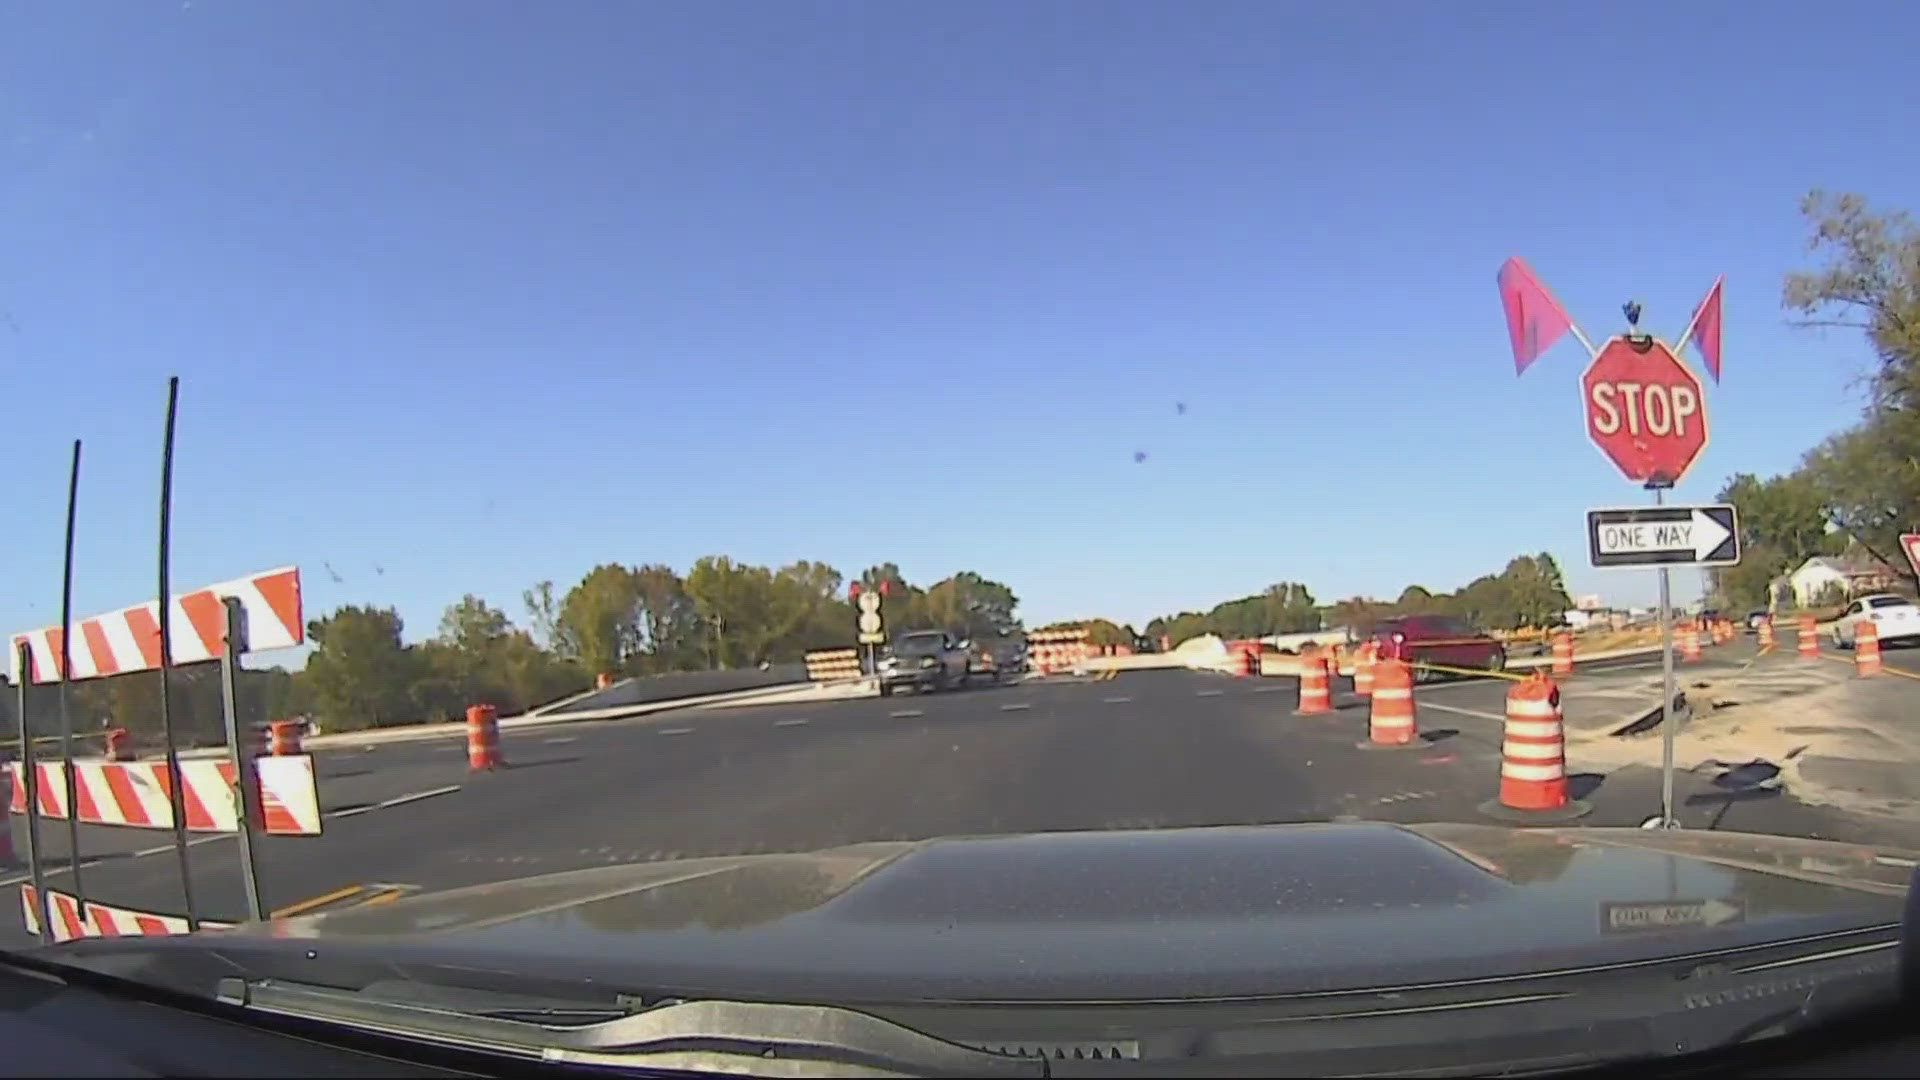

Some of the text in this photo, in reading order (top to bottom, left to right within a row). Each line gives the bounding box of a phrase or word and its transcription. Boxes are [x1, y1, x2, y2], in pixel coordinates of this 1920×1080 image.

[1592, 382, 1697, 437] STOP
[1604, 525, 1693, 549] ONE WAY
